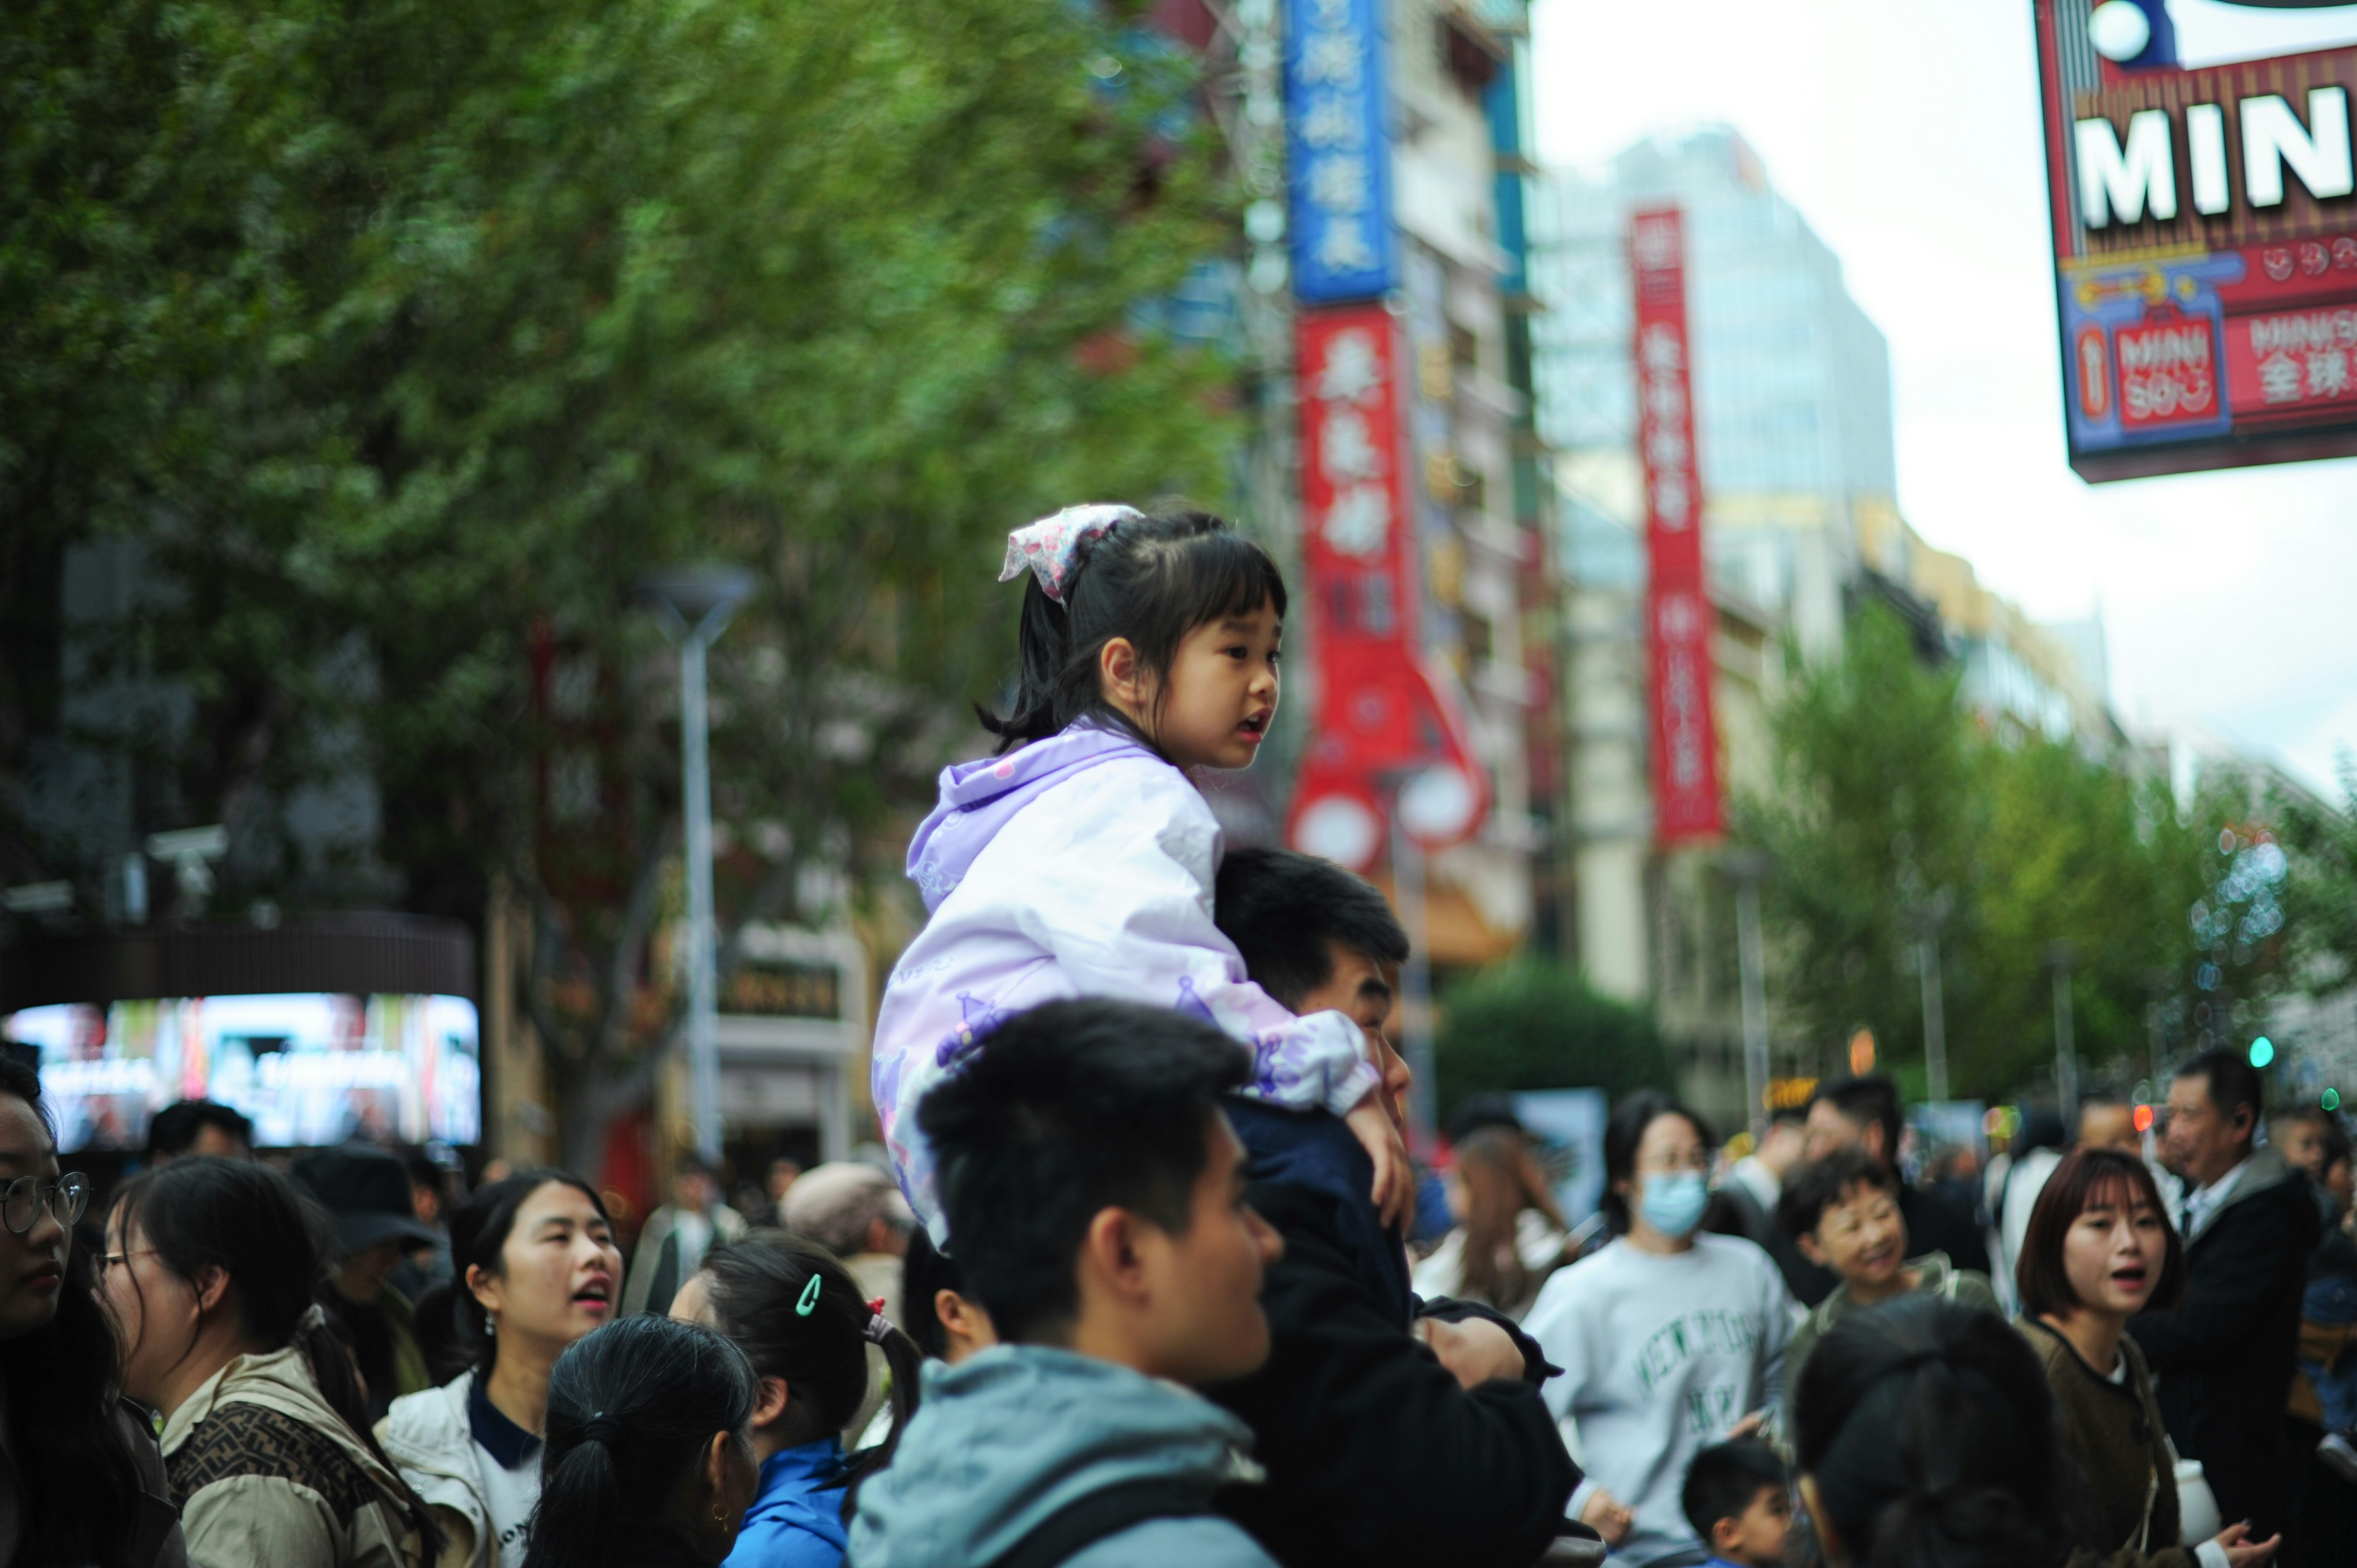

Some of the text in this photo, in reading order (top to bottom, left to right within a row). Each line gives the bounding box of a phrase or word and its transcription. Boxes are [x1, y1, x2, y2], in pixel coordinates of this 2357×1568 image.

[2074, 85, 2355, 230] MIN
[2118, 325, 2210, 374] MINI
[2250, 310, 2357, 359] MINIS
[2257, 350, 2357, 405] 全球
